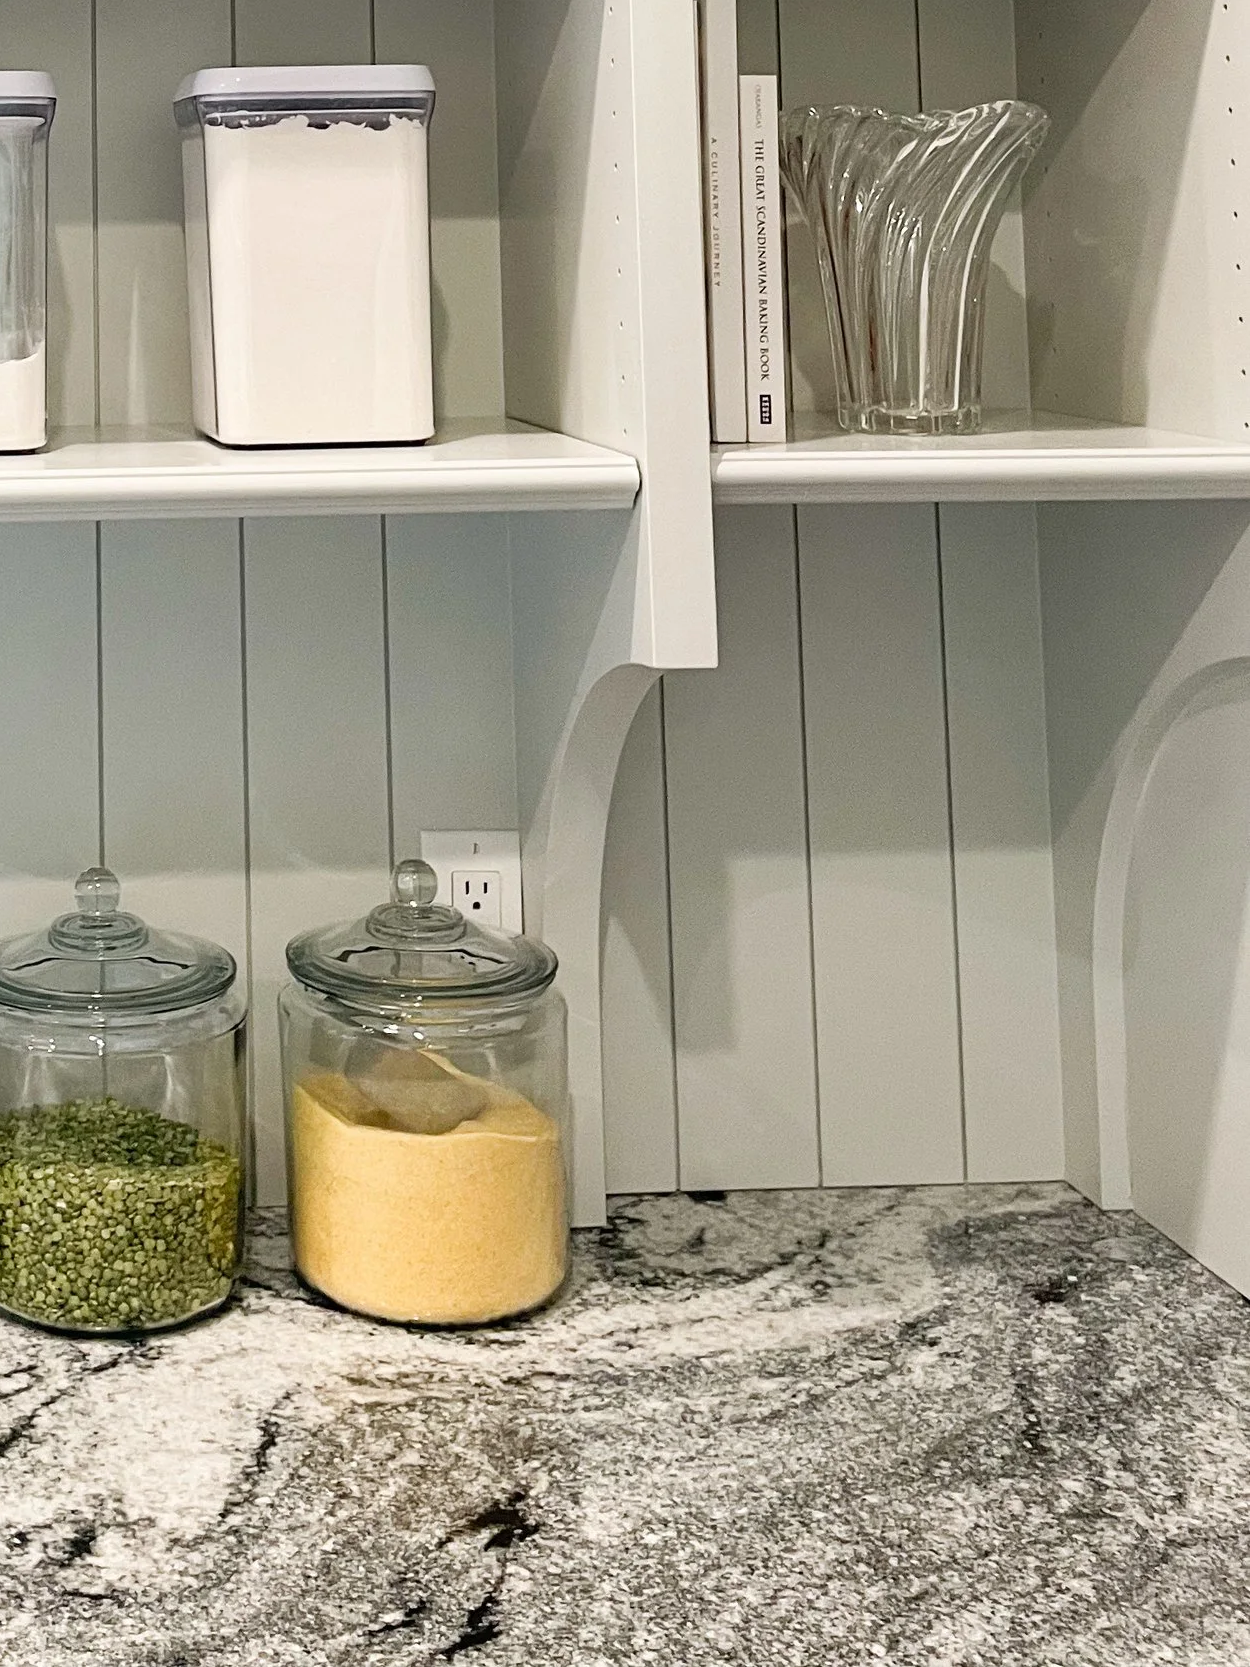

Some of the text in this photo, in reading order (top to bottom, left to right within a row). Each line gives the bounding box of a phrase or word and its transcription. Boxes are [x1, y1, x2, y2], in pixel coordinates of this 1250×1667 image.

[754, 138, 764, 162] THE
[711, 152, 720, 219] CULINARY
[755, 165, 765, 202] GREAT
[712, 226, 722, 288] JOURNEY
[756, 205, 768, 295] SCANDINAVIAN
[758, 298, 769, 343] BAKING
[759, 348, 770, 381] BOOK
